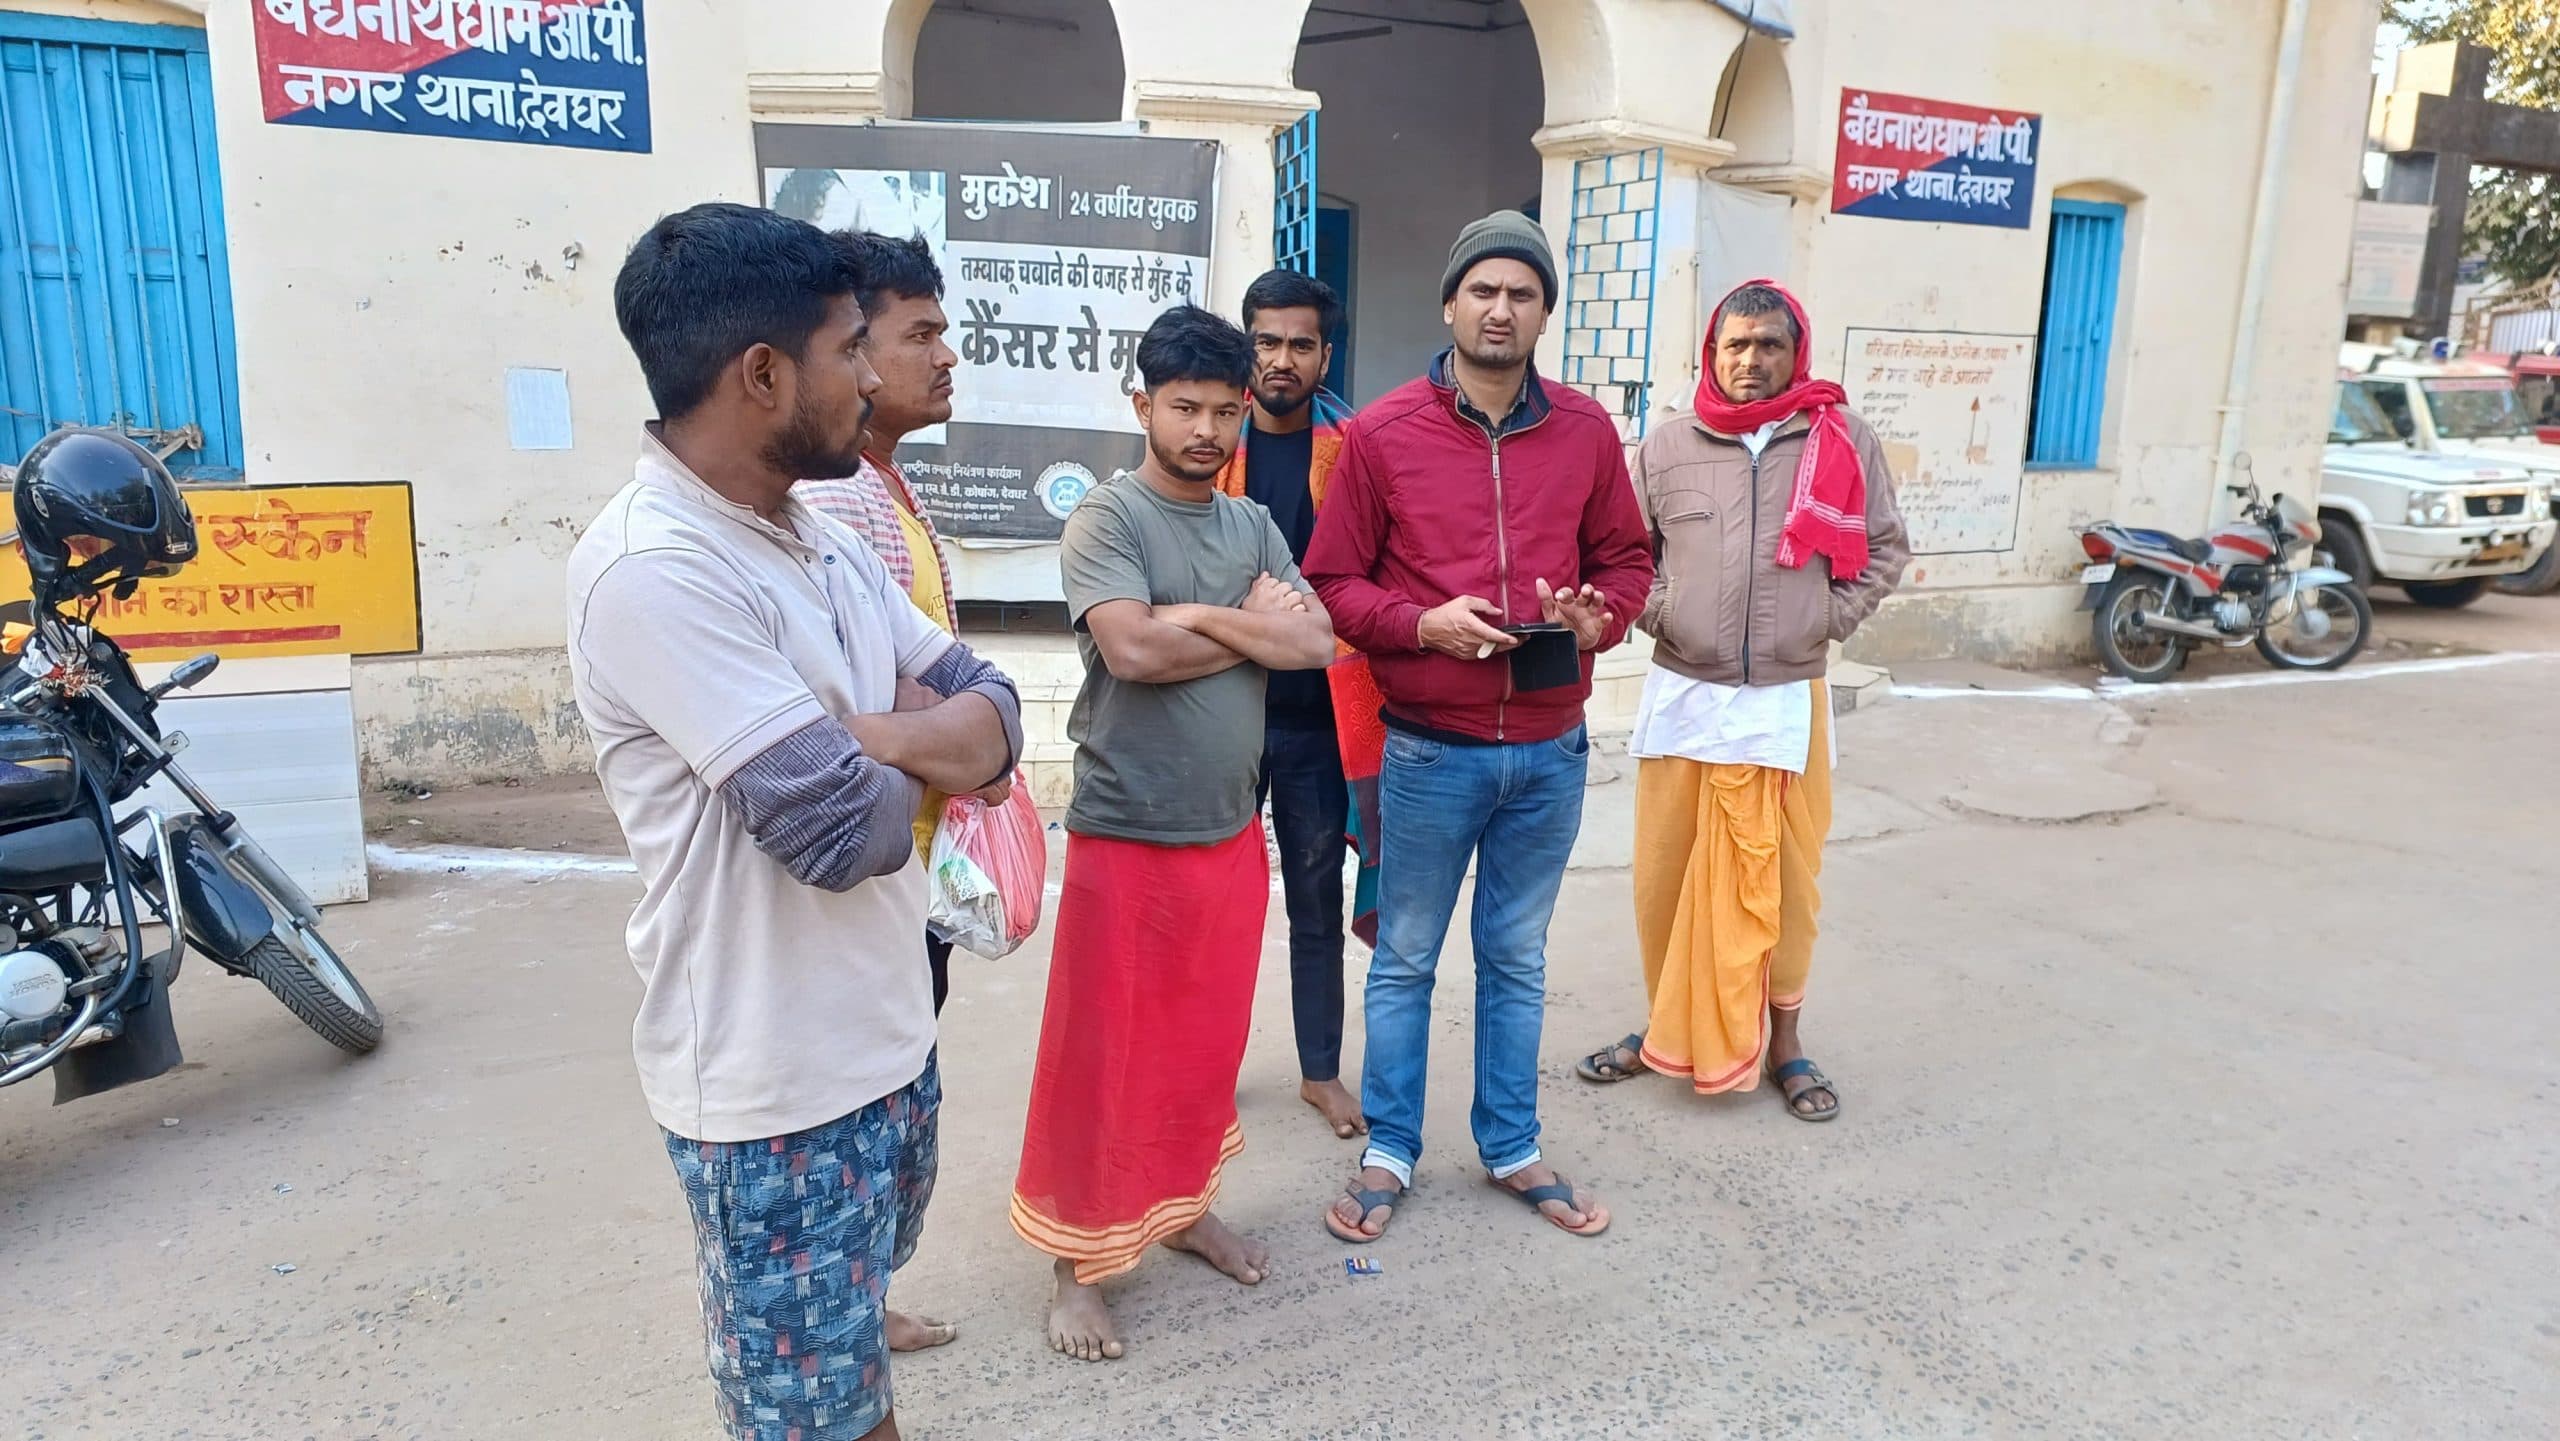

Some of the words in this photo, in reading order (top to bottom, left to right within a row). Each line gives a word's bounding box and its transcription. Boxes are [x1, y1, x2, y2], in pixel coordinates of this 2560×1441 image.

[279, 65, 407, 122] नगर
[959, 160, 1051, 221] मुकेश
[1847, 164, 1899, 200] नगर
[1070, 191, 1090, 216] 24
[1094, 184, 1145, 219] वर्षीय
[1148, 197, 1199, 230] युवक
[961, 257, 1018, 295] तम्बाकू
[1018, 251, 1063, 287] चबाने
[1067, 253, 1089, 288] की
[1092, 264, 1128, 294] वजह
[1131, 255, 1145, 291] से
[1147, 256, 1173, 303] मुँह
[1175, 260, 1194, 296] के
[1067, 305, 1101, 372] से
[902, 460, 930, 476] राष्ट्रीय
[953, 462, 985, 478] नियंत्रण
[986, 465, 1022, 480] कार्यक्रम
[1001, 486, 1028, 500] देवघर
[158, 586, 208, 618] का
[218, 583, 316, 614] रास्ता
